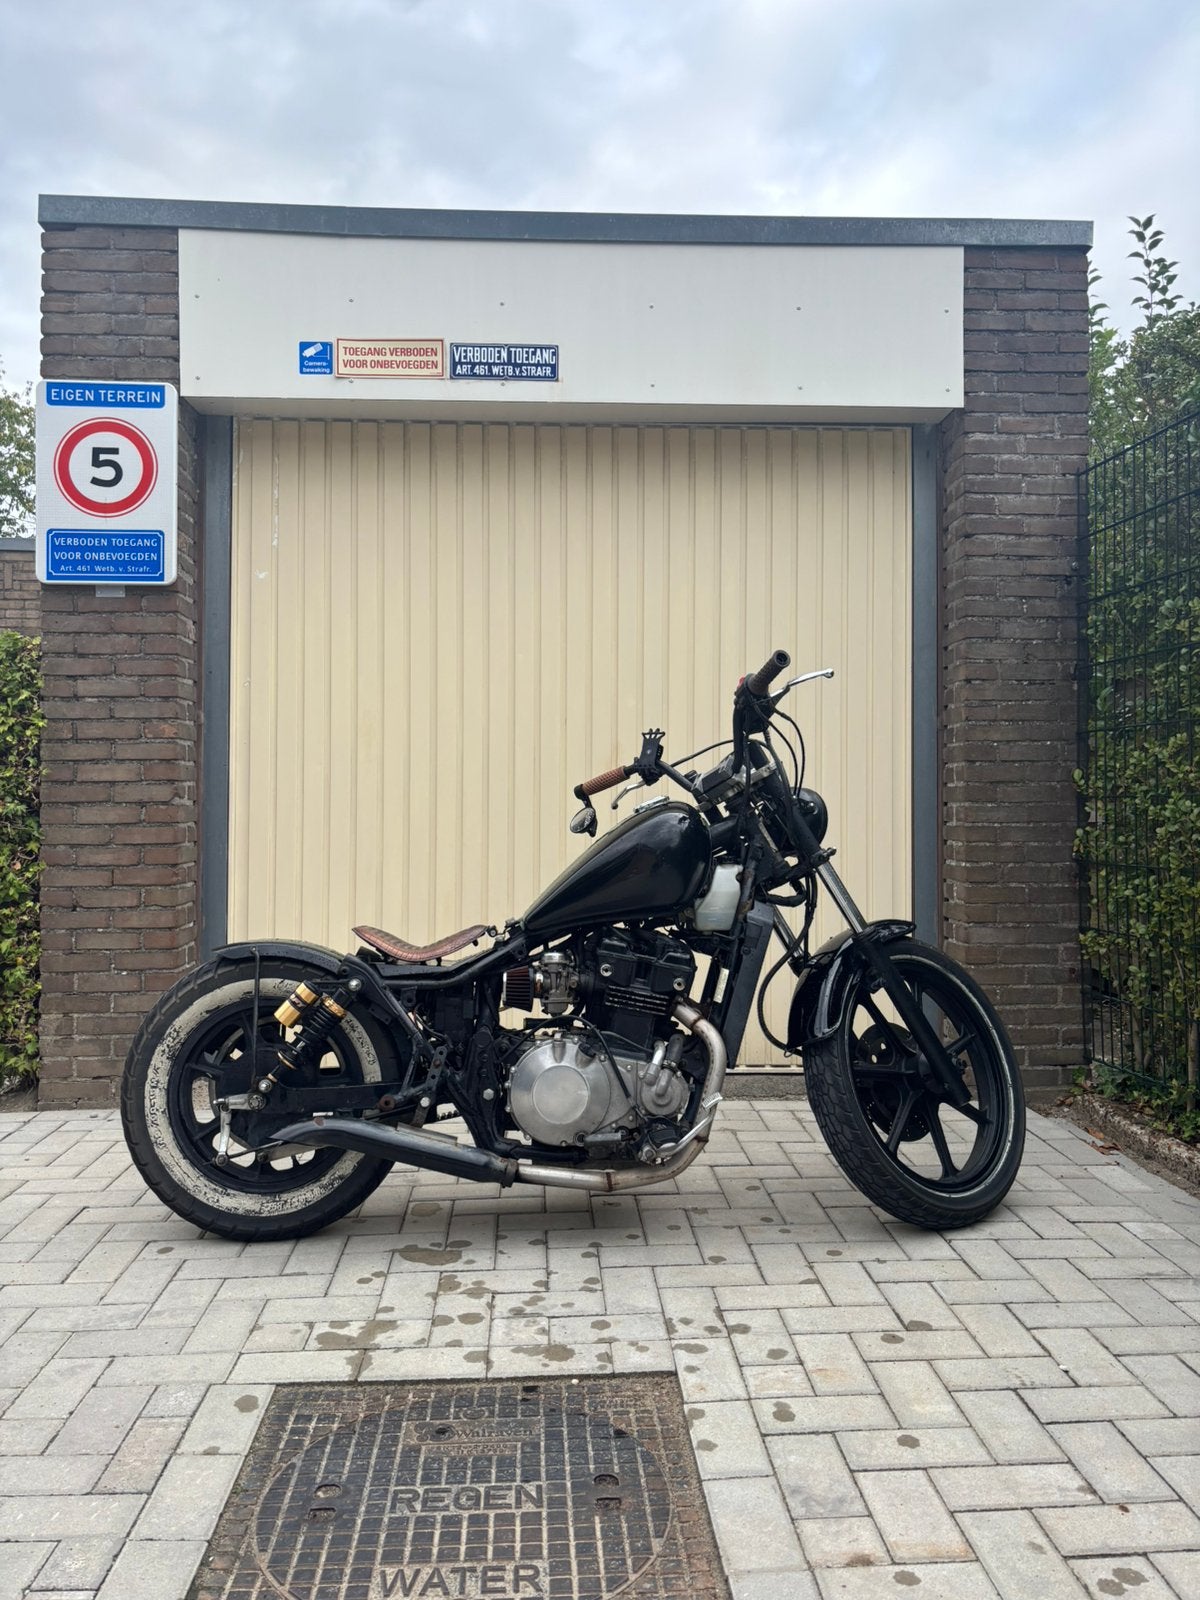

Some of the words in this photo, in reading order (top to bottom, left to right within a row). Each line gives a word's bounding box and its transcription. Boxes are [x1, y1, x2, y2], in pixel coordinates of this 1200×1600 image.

[342, 346, 387, 357] TOEGANG
[388, 347, 438, 357] VERBODEN
[453, 346, 507, 363] VERBODEN
[510, 348, 556, 364] TOEGANG
[342, 359, 368, 369] VOOR
[369, 359, 438, 370] ONBEVOEGDEN
[51, 388, 95, 402] EIGEN
[98, 389, 161, 404] TERREIN
[90, 446, 123, 488] 5
[54, 537, 108, 547] VERBODEN
[111, 538, 158, 547] TOEGANG
[54, 551, 82, 560] VOOR
[84, 552, 158, 561] ONBEVOEGDEN
[60, 564, 75, 572] Art.
[389, 1484, 544, 1514] REGEN
[379, 1564, 544, 1598] WATER
